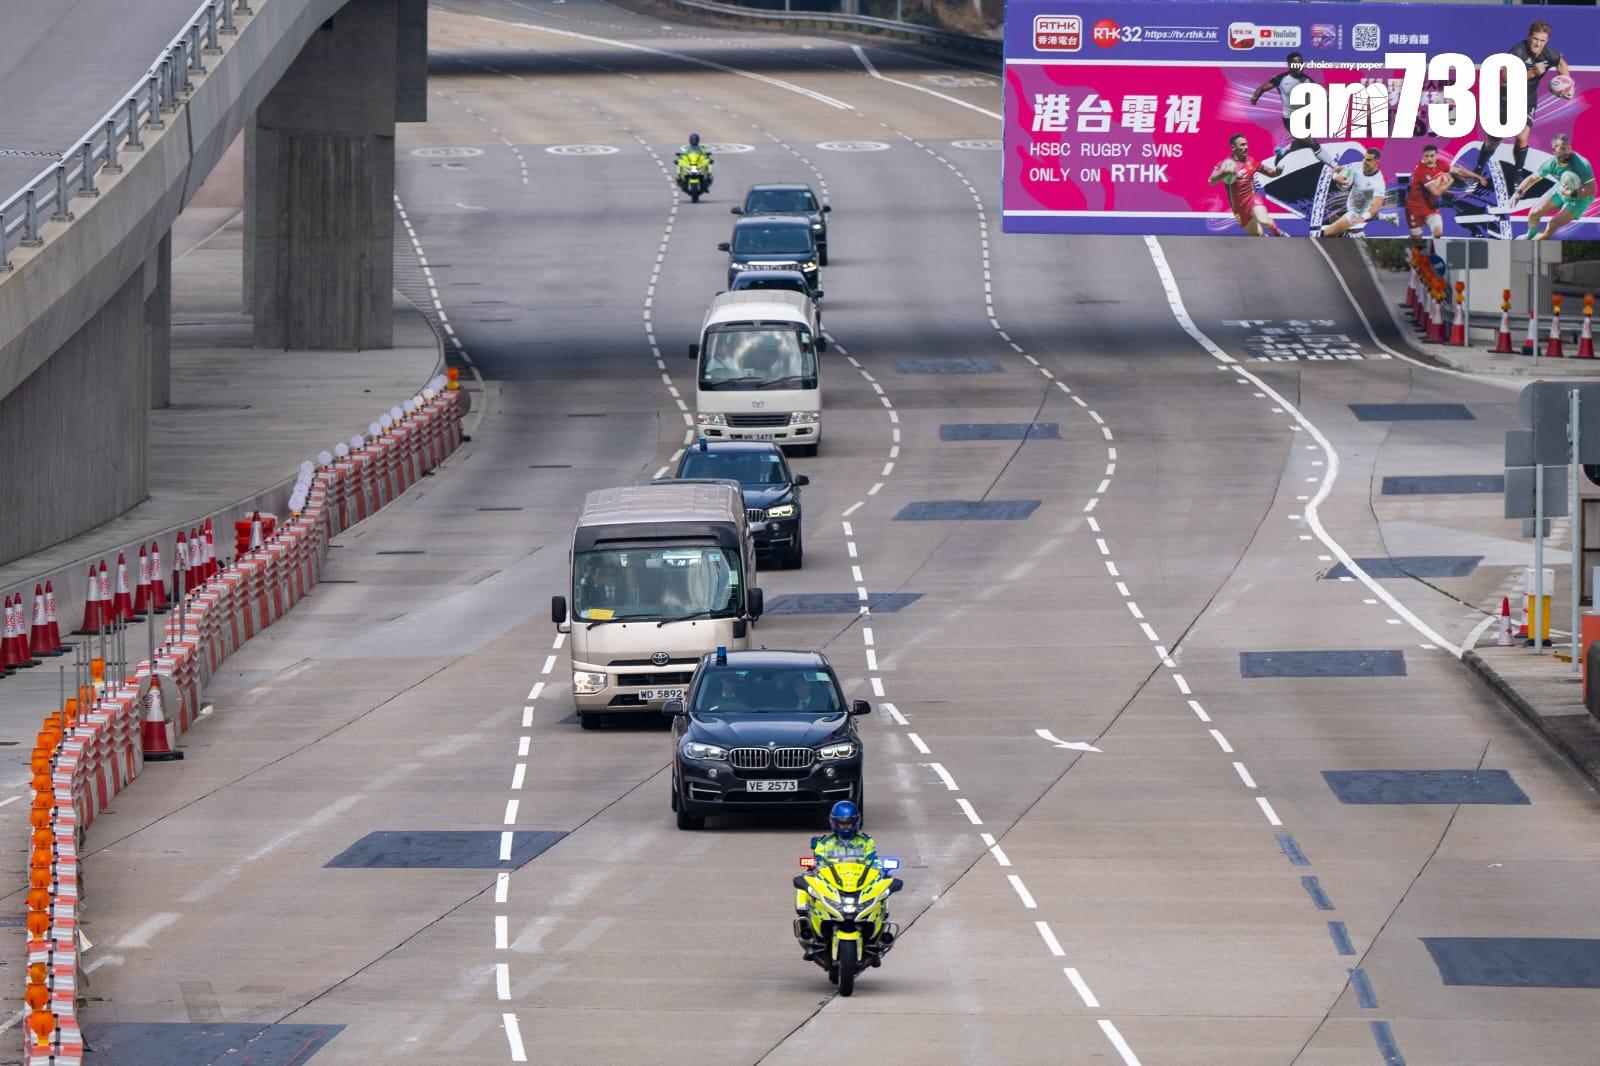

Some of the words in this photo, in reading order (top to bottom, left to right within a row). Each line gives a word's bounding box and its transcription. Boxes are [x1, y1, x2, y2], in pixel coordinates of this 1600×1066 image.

[1039, 21, 1077, 30] RTHK
[1144, 30, 1218, 41] https://tv.rthk.hk
[1273, 30, 1297, 39] YouTube
[1037, 35, 1078, 46] 香港電台
[1031, 93, 1203, 134] 港台電視
[1029, 142, 1071, 156] HSBC
[1080, 143, 1132, 157] RUGBY
[1141, 143, 1184, 158] SVNS
[1029, 167, 1071, 182] ONLY
[1080, 168, 1101, 182] ON
[1111, 164, 1169, 183] RTHK
[640, 690, 654, 699] WD
[657, 689, 683, 699] 5892
[749, 781, 763, 791] VE
[767, 781, 796, 791] 2573
